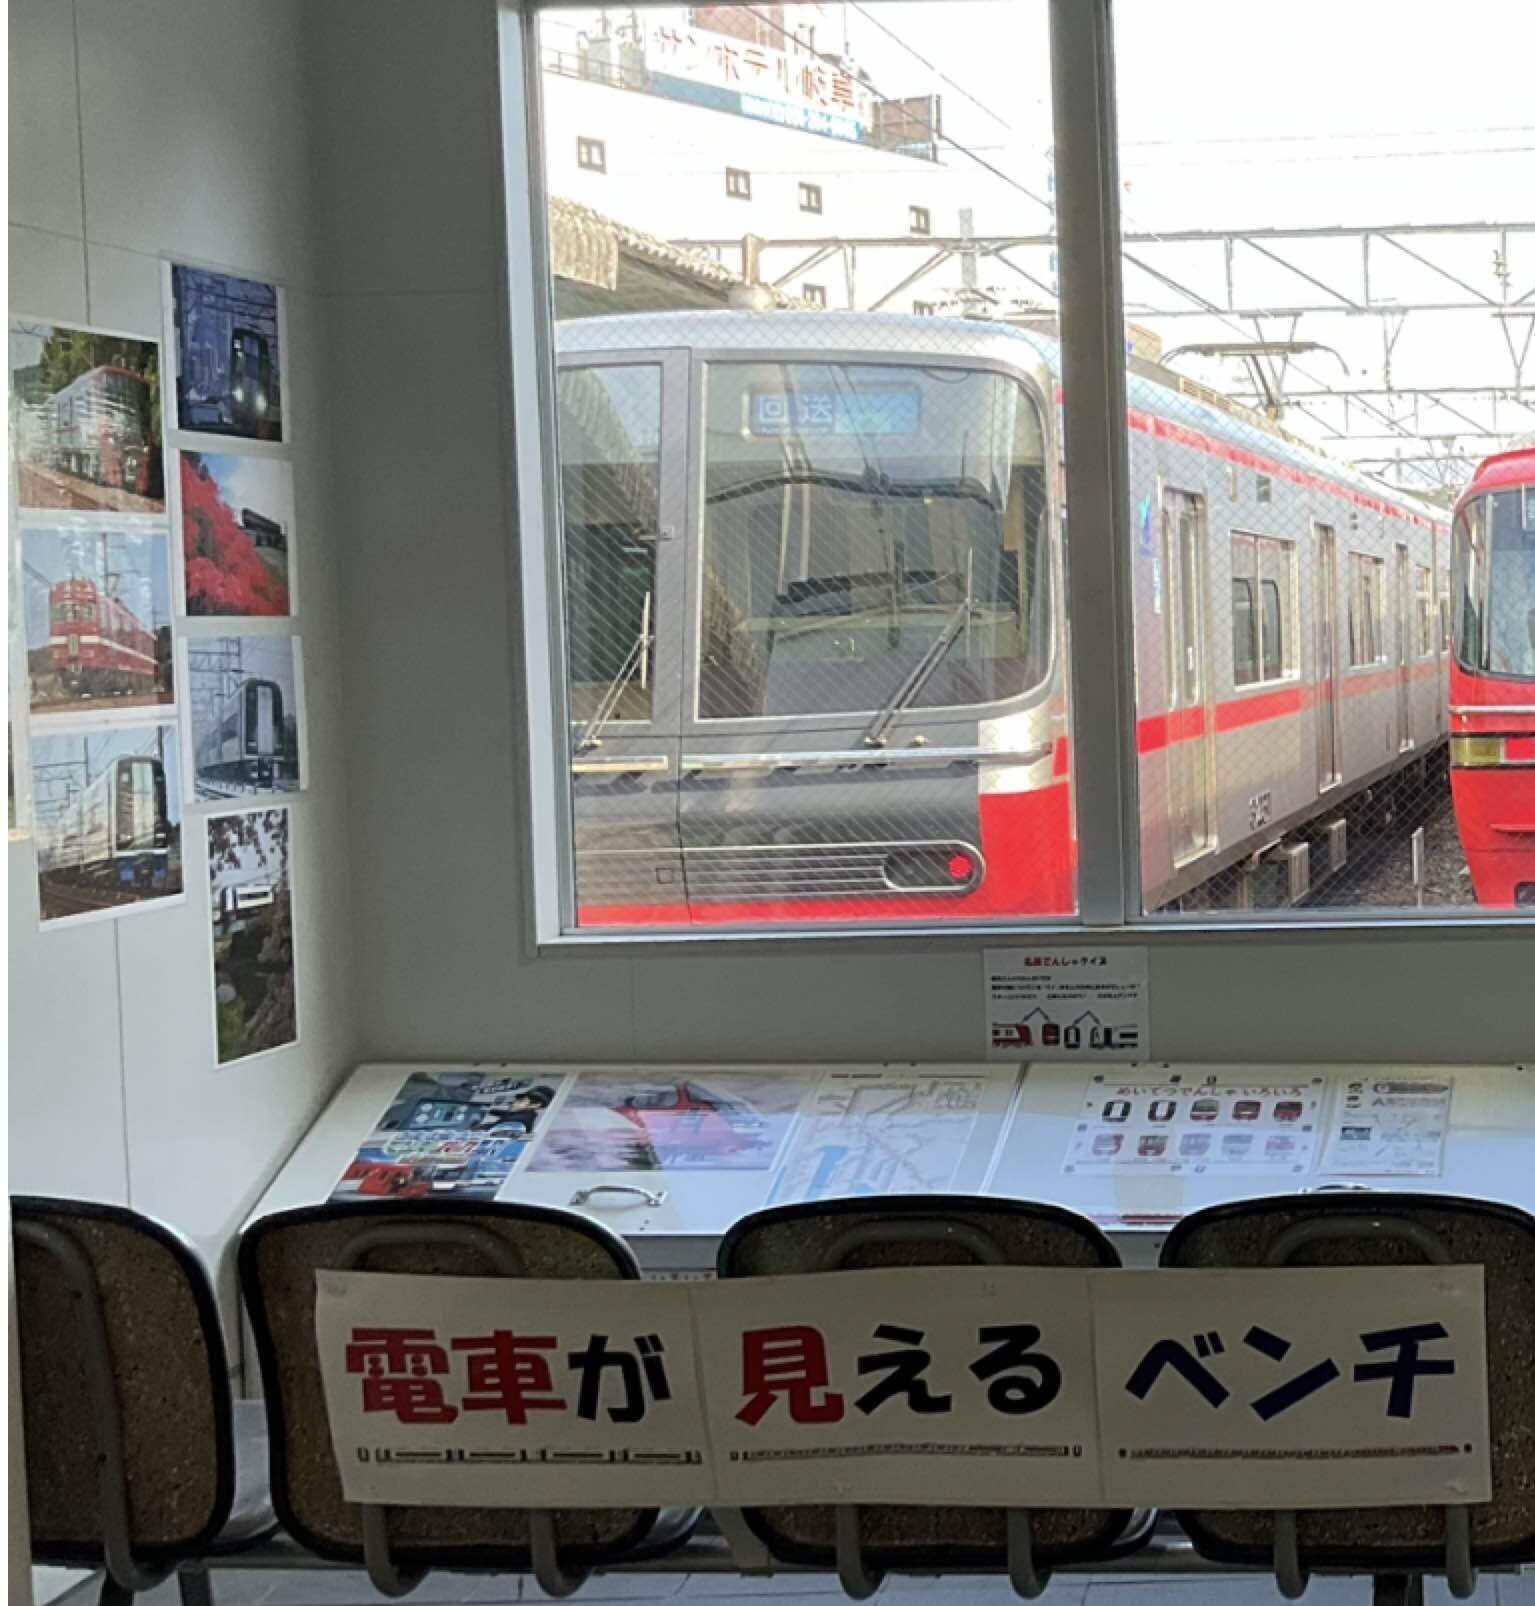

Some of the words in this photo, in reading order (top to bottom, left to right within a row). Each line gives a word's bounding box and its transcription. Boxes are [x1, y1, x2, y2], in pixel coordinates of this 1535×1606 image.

[759, 393, 832, 423] 回送
[345, 1326, 674, 1426] 電車が
[734, 1323, 1064, 1426] 見える
[1123, 1321, 1456, 1422] ベンチ
